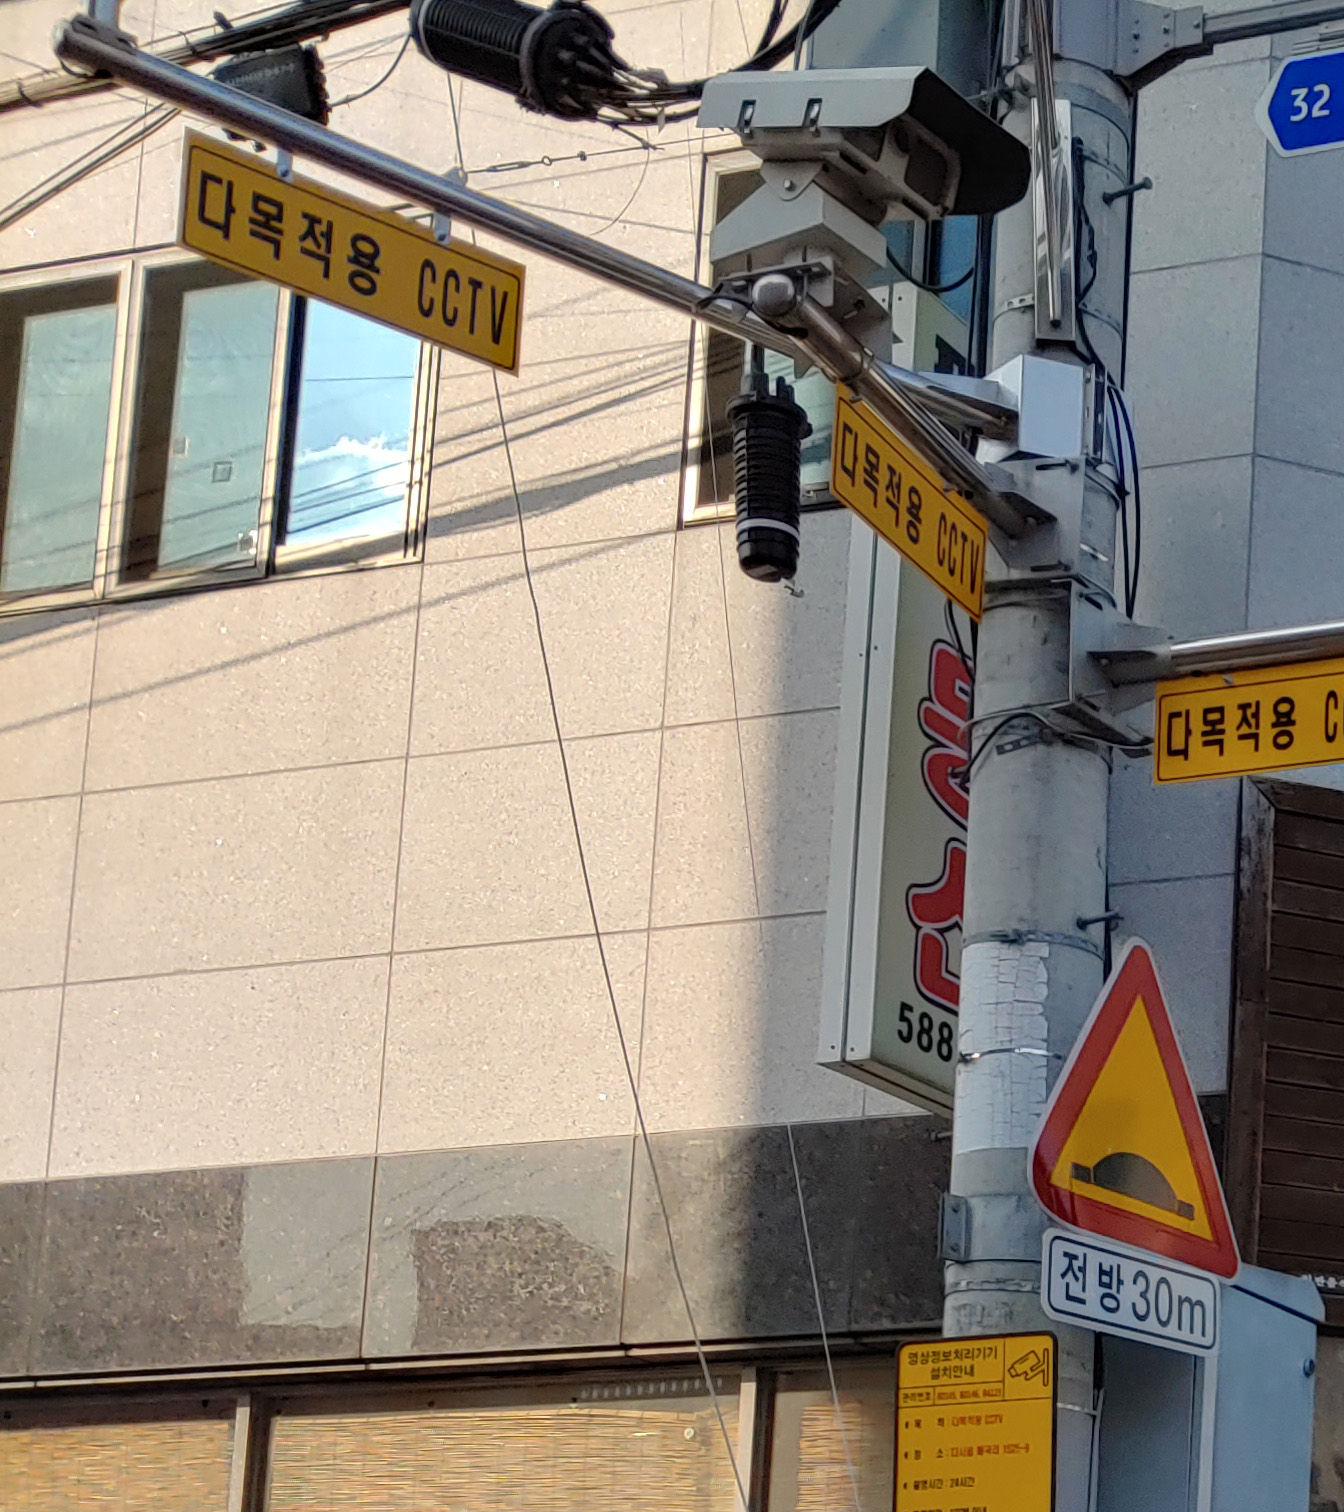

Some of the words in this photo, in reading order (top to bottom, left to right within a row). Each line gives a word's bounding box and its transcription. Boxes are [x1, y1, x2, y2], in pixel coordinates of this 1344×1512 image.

[1289, 84, 1332, 121] 32
[196, 169, 384, 298] 다목적용
[416, 257, 510, 347] CCTV
[840, 420, 923, 545] 다목적용
[936, 511, 982, 596] CCTV
[1166, 696, 1298, 762] 다목적용
[930, 1364, 975, 1380] 설치안내
